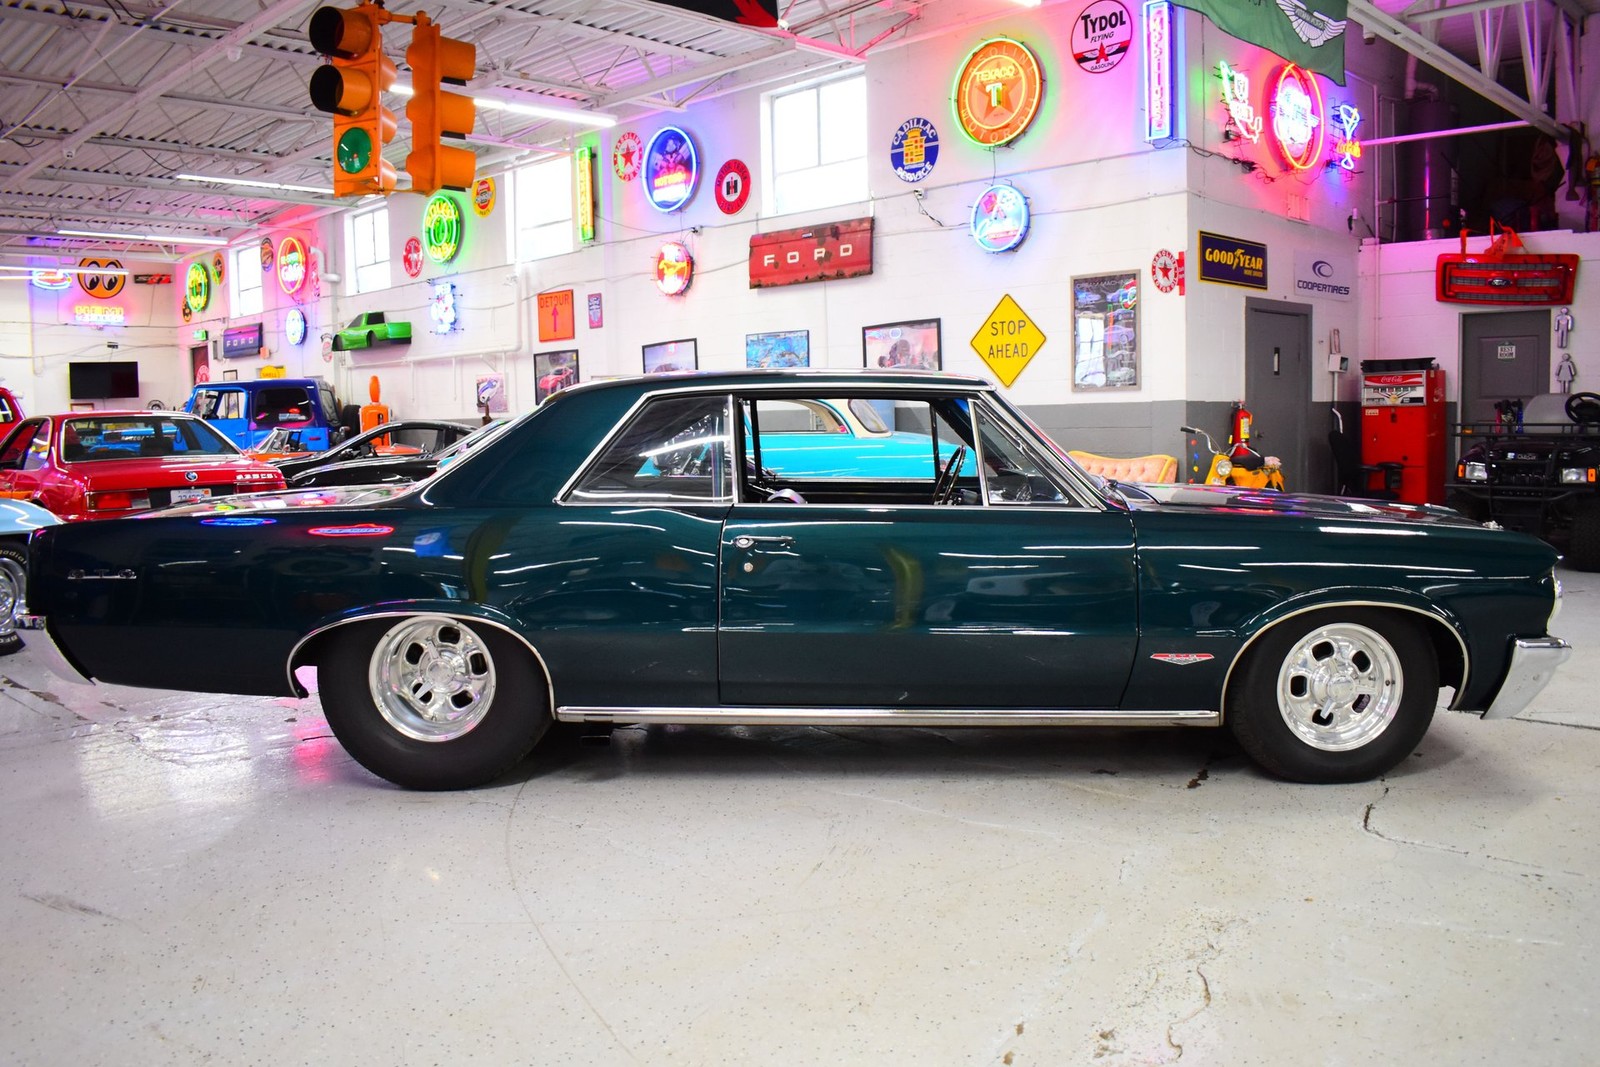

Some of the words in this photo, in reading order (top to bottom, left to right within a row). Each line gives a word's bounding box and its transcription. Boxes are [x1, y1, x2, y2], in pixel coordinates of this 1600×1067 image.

[1081, 10, 1126, 39] TYDOL
[1090, 31, 1115, 43] FLYING
[974, 64, 1016, 82] TEXACO
[1090, 61, 1115, 71] GASOLINE
[893, 119, 936, 145] CADILLAC
[894, 161, 933, 182] SERVICE
[764, 244, 852, 267] FORD
[1205, 247, 1263, 270] GOODYEAR
[540, 293, 569, 309] DETOUR
[991, 319, 1026, 336] STOP
[226, 336, 254, 348] FORD
[988, 342, 1028, 358] AHEAD
